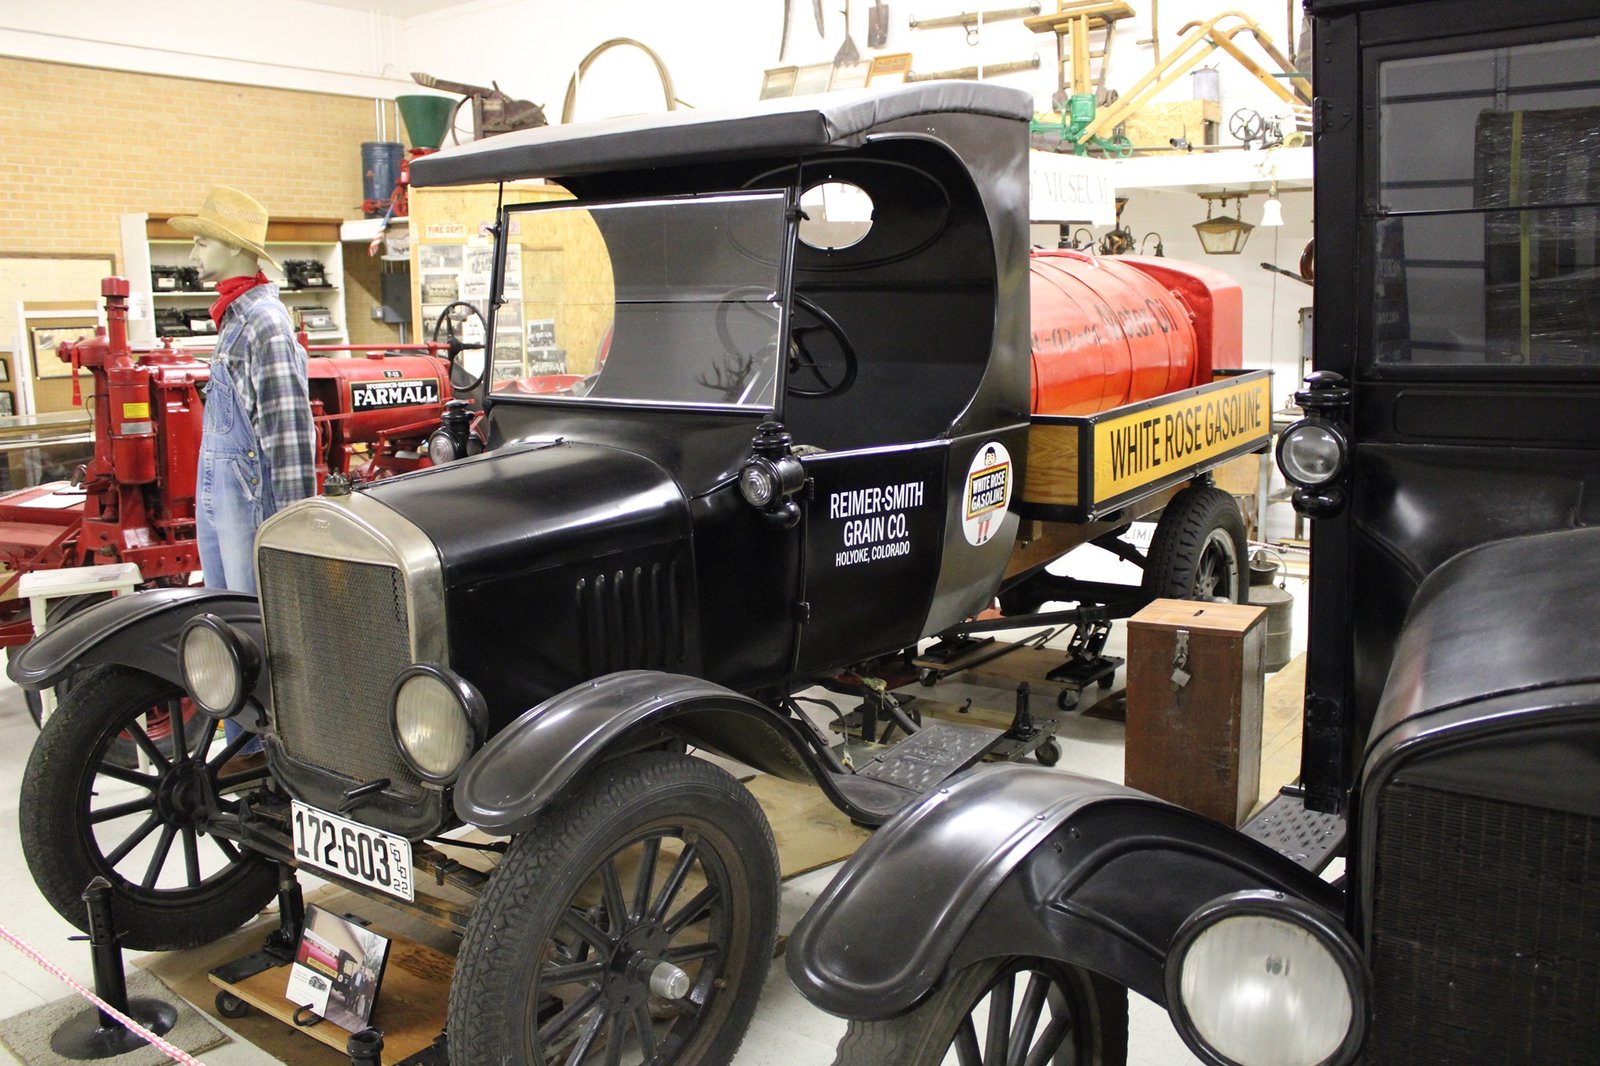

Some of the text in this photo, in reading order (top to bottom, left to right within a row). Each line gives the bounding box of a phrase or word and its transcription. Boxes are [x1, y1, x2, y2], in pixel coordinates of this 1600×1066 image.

[1043, 171, 1108, 205] MUSEUM
[428, 225, 443, 234] FIRE
[353, 386, 438, 407] FARMALL
[1110, 387, 1262, 482] WHITE ROSE GASOLINE
[972, 470, 1006, 494] WHITE ROSE
[971, 486, 1004, 511] GASOLINE
[843, 513, 909, 547] GRAIN CO.
[835, 540, 911, 567] HOLYOKE, COLORADO
[393, 878, 409, 895] 22
